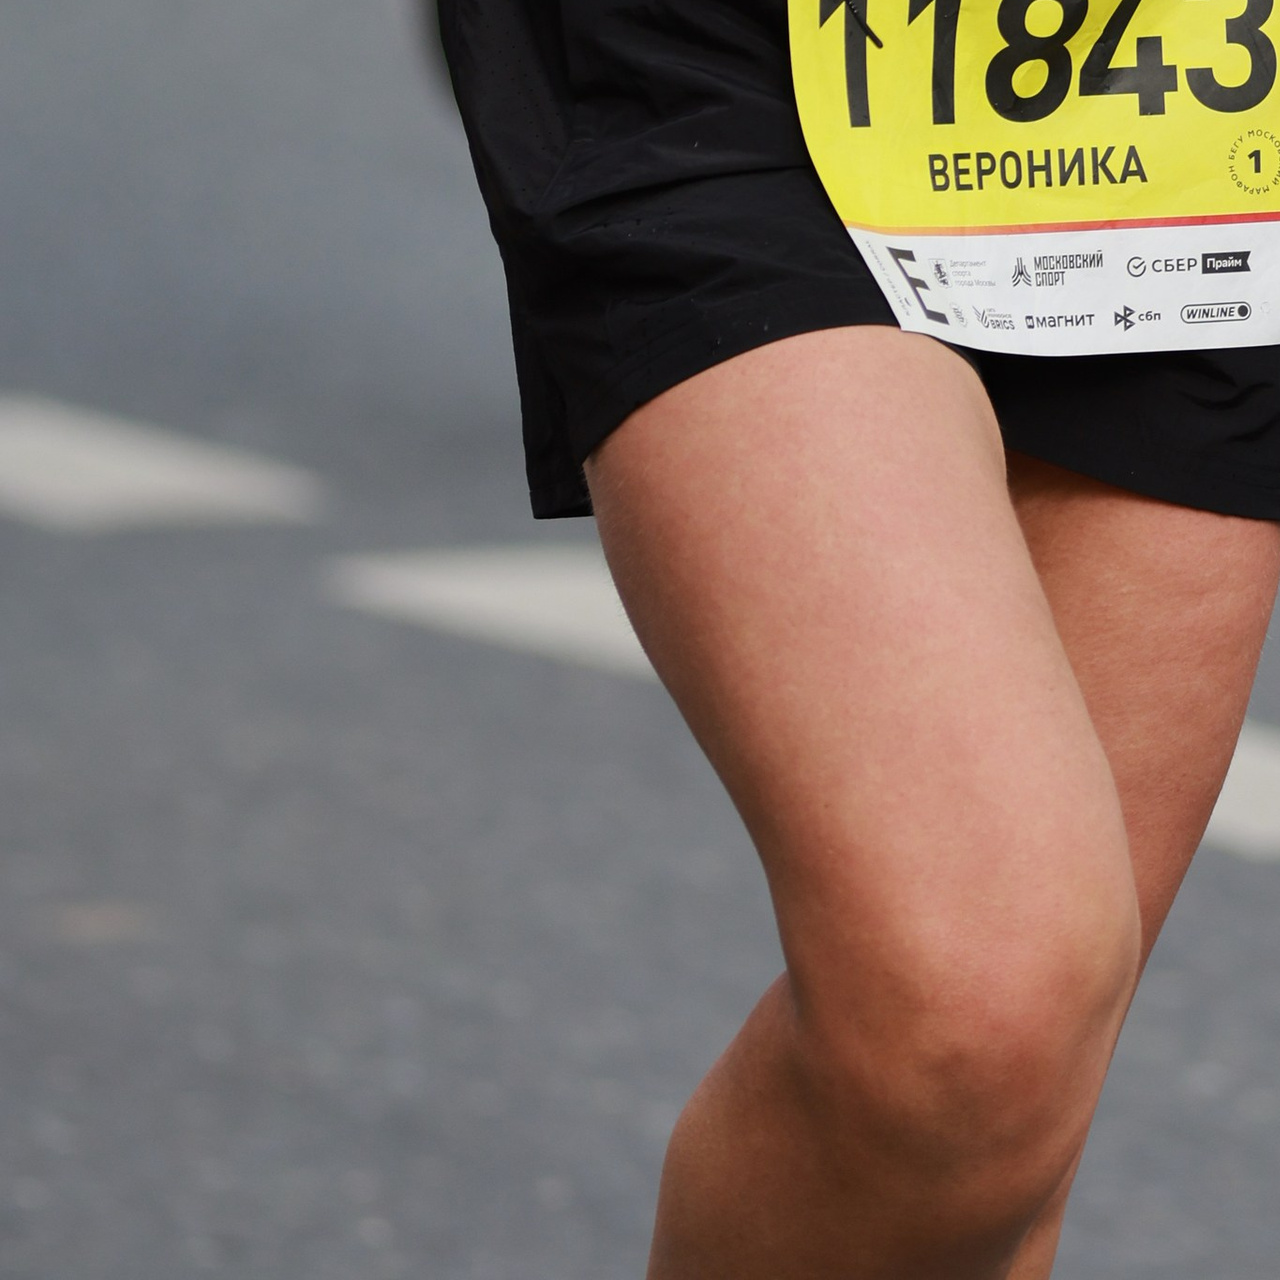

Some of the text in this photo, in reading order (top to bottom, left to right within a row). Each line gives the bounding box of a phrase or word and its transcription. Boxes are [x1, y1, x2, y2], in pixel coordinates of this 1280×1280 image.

[928, 145, 1148, 192] ВЕРОНИКА
[1248, 149, 1261, 173] 1
[1034, 249, 1103, 271] МОСКОВСКИЙ
[1152, 257, 1242, 272] СБЕР Прайм
[1035, 271, 1065, 287] СПОРТ
[1138, 311, 1161, 322] сбп
[1186, 306, 1236, 320] WINLINE
